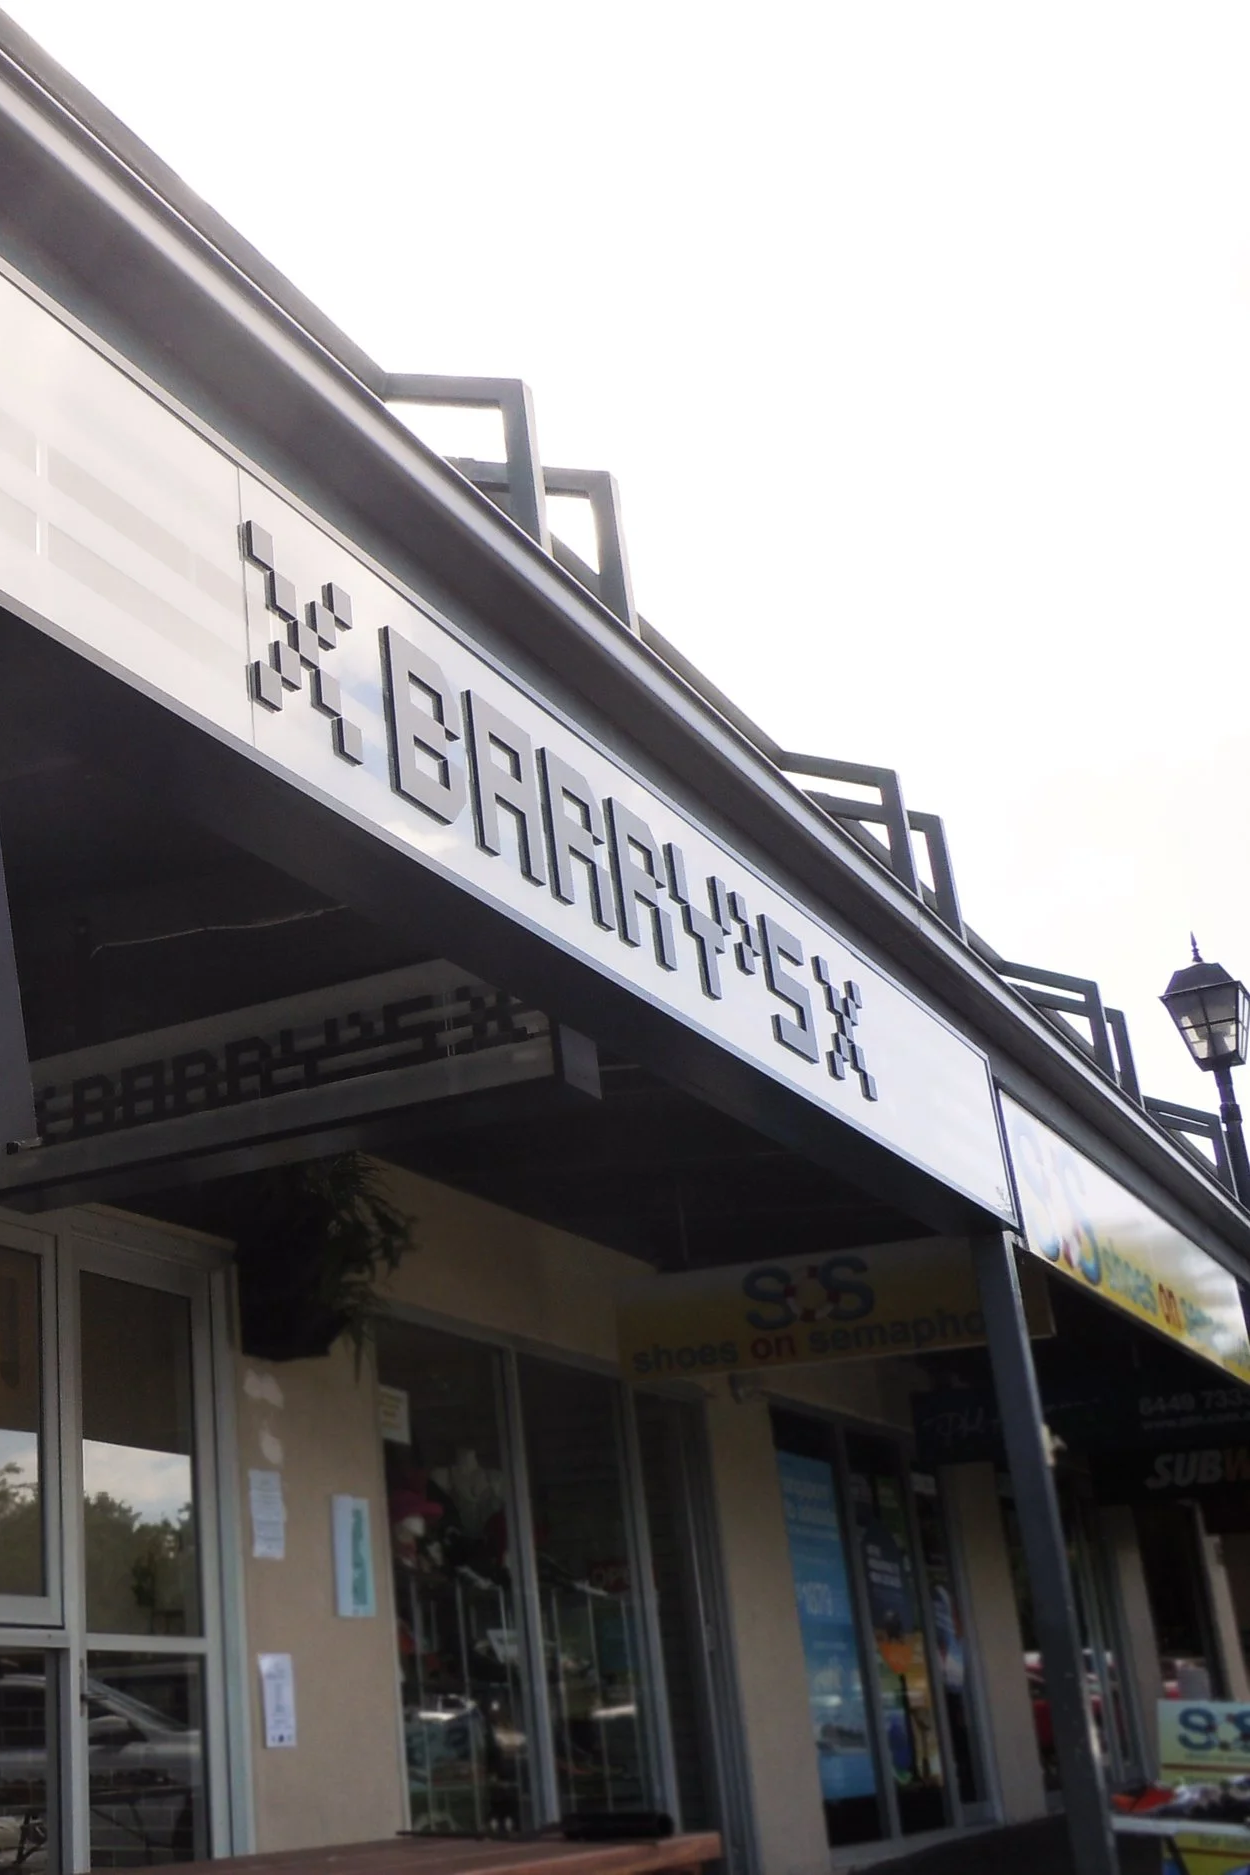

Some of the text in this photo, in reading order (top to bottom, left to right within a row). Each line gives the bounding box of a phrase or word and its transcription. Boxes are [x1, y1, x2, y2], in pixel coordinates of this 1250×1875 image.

[631, 1307, 986, 1374] shoes on semapho
